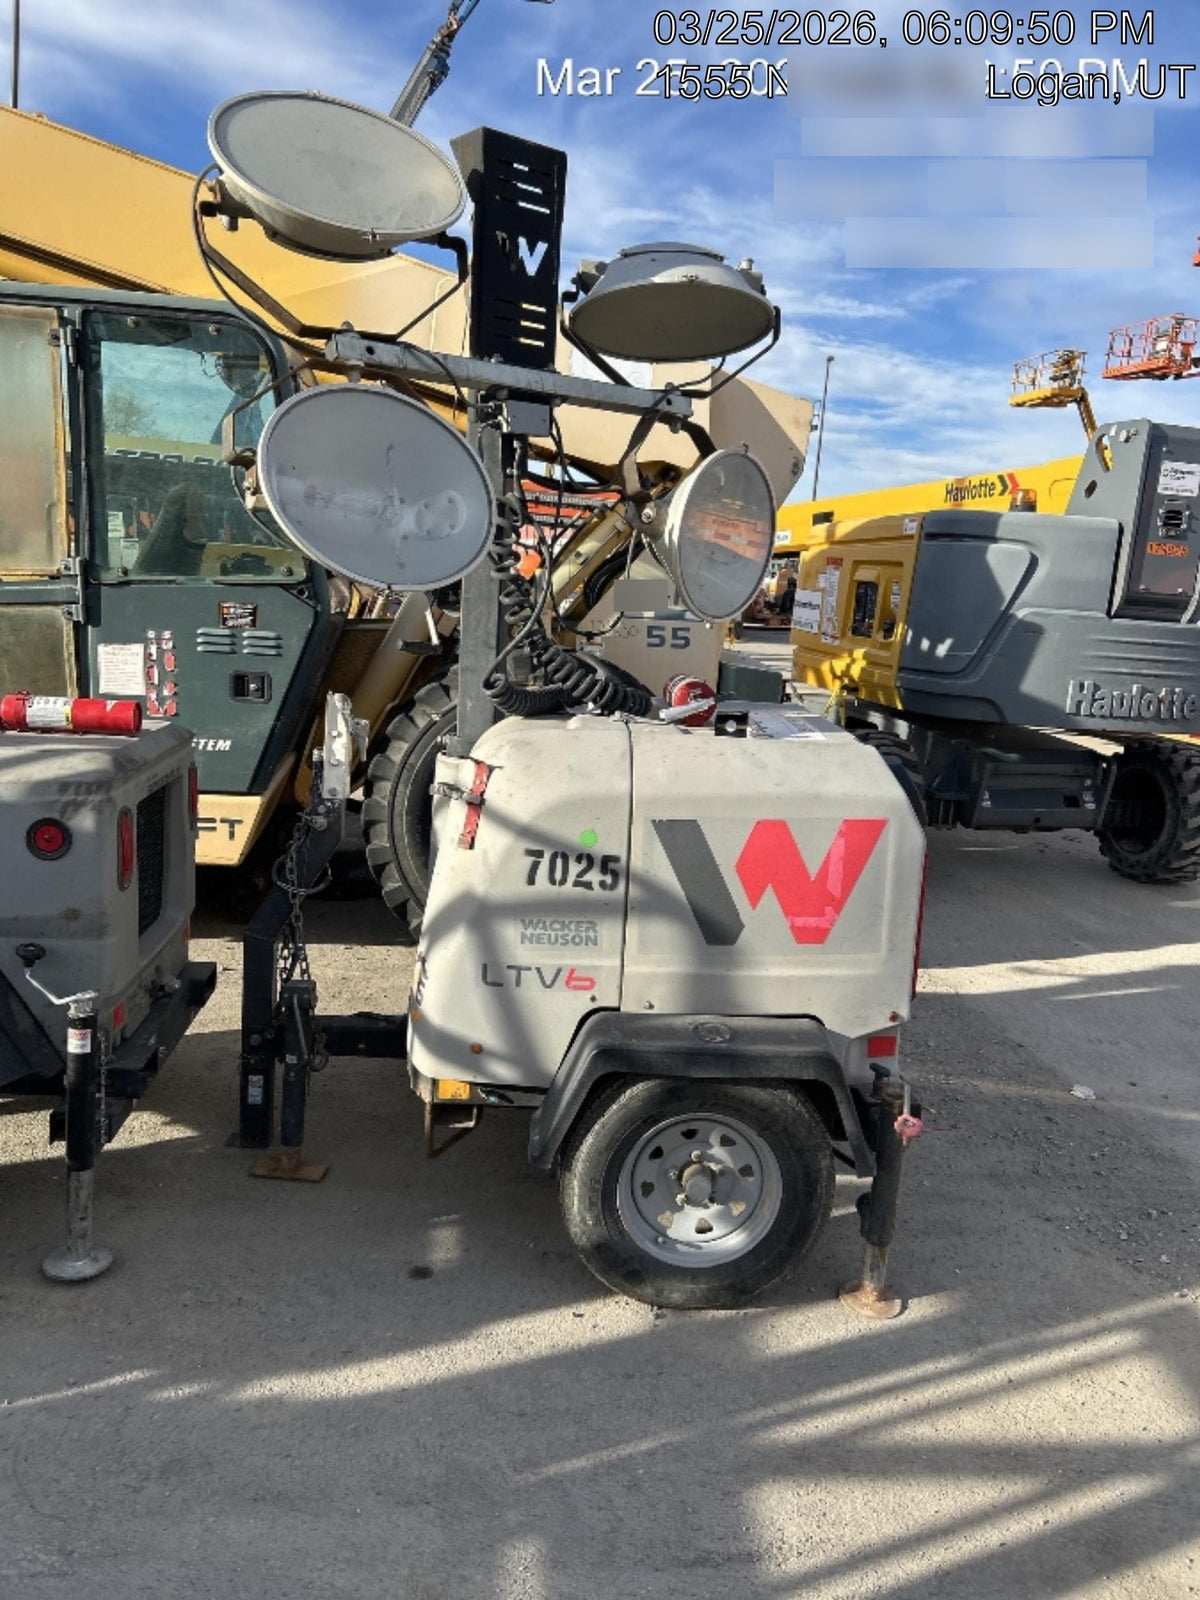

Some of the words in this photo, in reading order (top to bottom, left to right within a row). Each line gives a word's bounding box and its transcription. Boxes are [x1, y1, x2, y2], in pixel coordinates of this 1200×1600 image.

[944, 478, 996, 504] Haulotte
[646, 625, 690, 649] 55
[1065, 680, 1200, 720] Haulotte
[524, 848, 621, 892] 7025
[520, 918, 599, 934] WACKER
[520, 932, 598, 947] NEUSON
